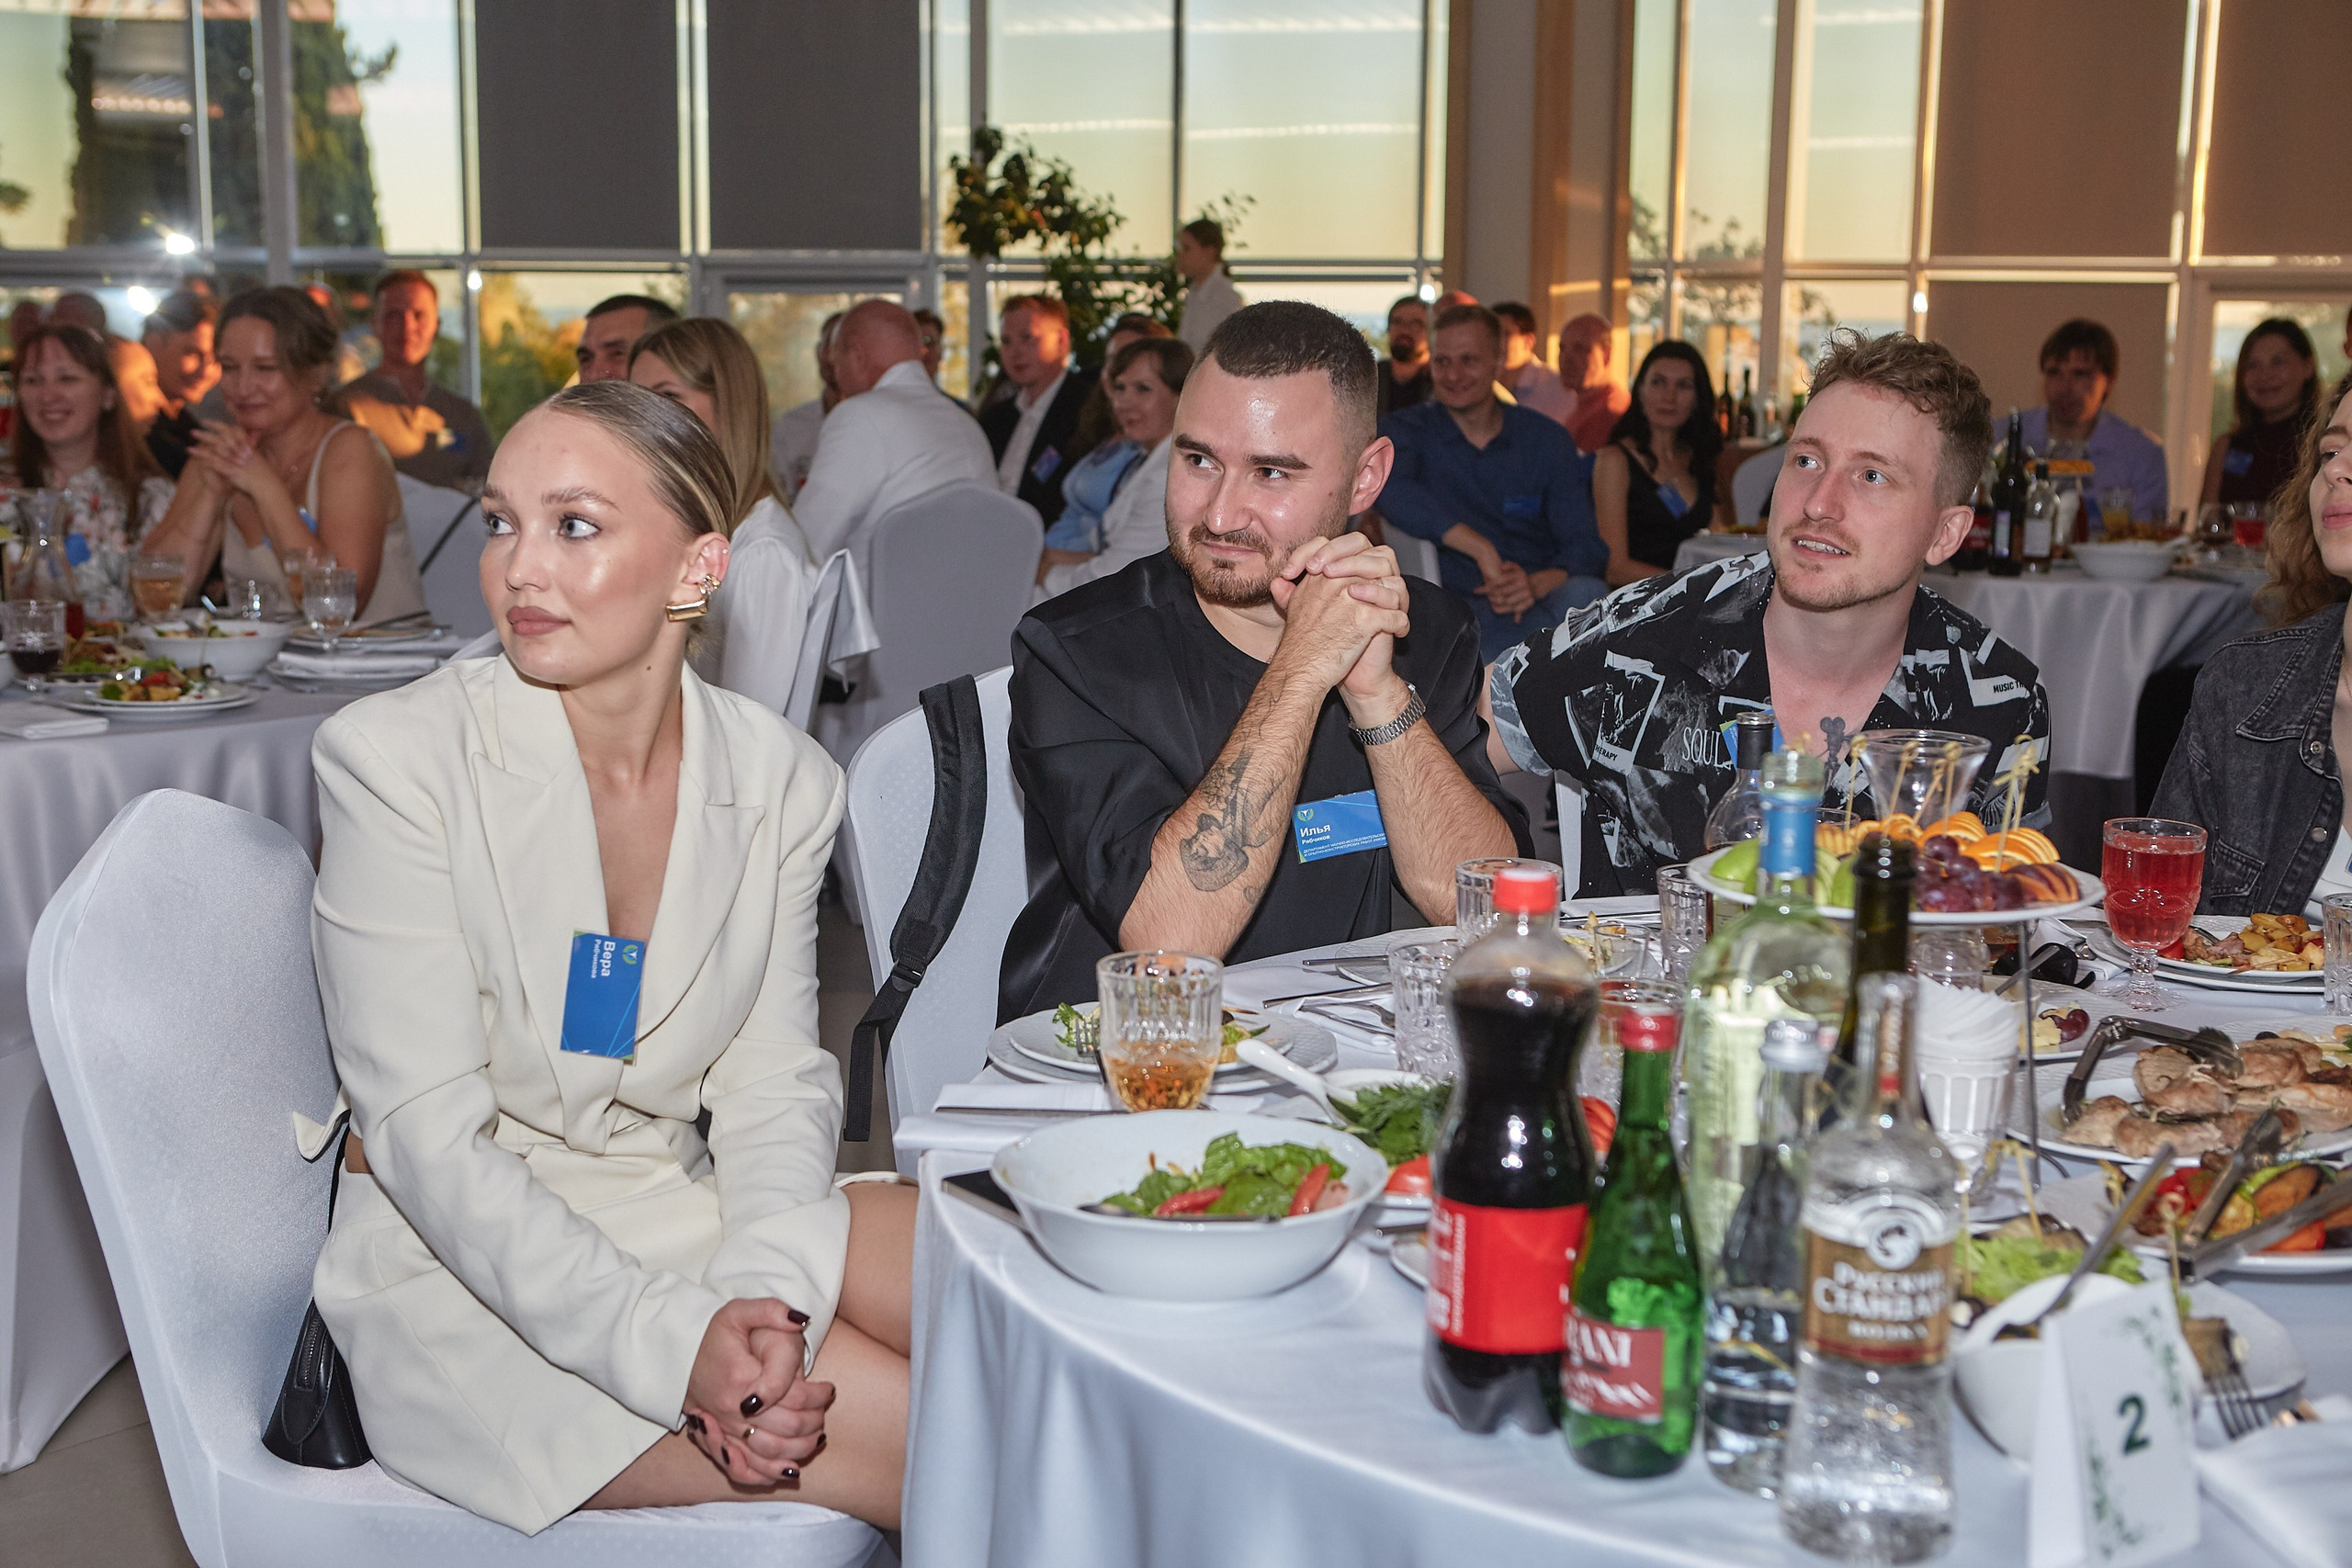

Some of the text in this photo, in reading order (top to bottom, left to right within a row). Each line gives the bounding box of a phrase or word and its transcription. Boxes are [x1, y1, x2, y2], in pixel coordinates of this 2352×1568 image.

[1993, 682, 2014, 693] MUSIC
[1682, 727, 1723, 768] SOUL
[1300, 824, 1330, 837] Илья
[1301, 835, 1330, 845] Рябчиков
[601, 941, 616, 977] Вера
[2117, 1393, 2152, 1457] 2
